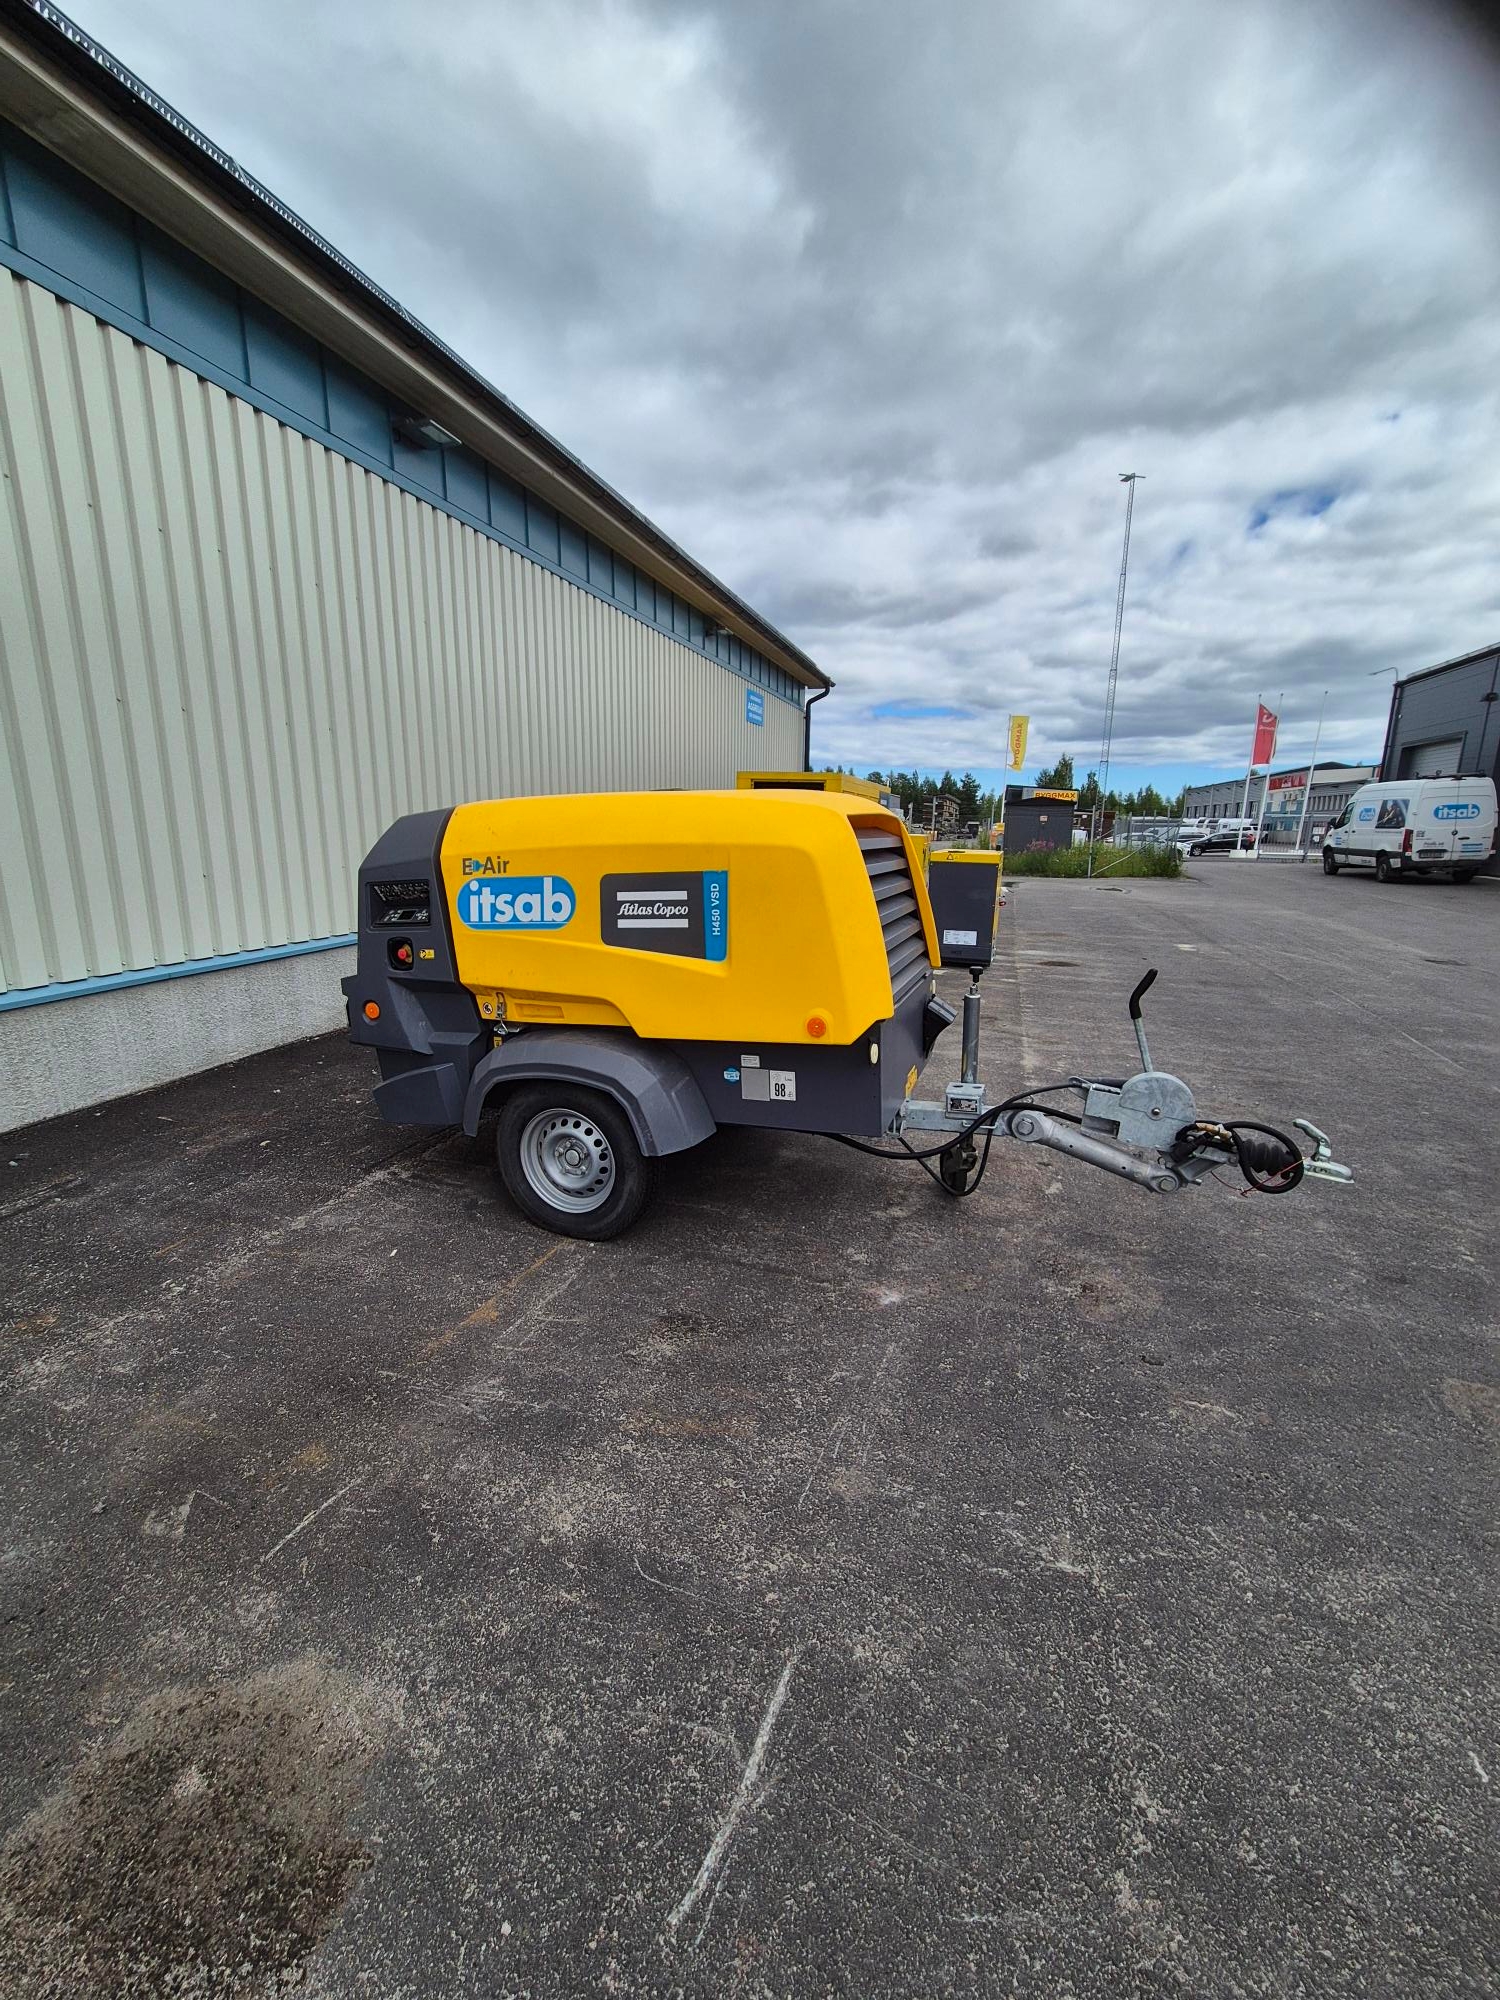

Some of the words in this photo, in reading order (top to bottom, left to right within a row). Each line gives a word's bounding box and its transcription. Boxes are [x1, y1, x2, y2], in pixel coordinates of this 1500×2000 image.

[1439, 804, 1479, 818] itsab
[469, 877, 572, 923] itsab
[711, 883, 720, 906] VSD
[617, 903, 652, 915] Atlas
[653, 902, 689, 918] Copco
[711, 909, 721, 936] H450
[775, 1083, 785, 1097] 98
